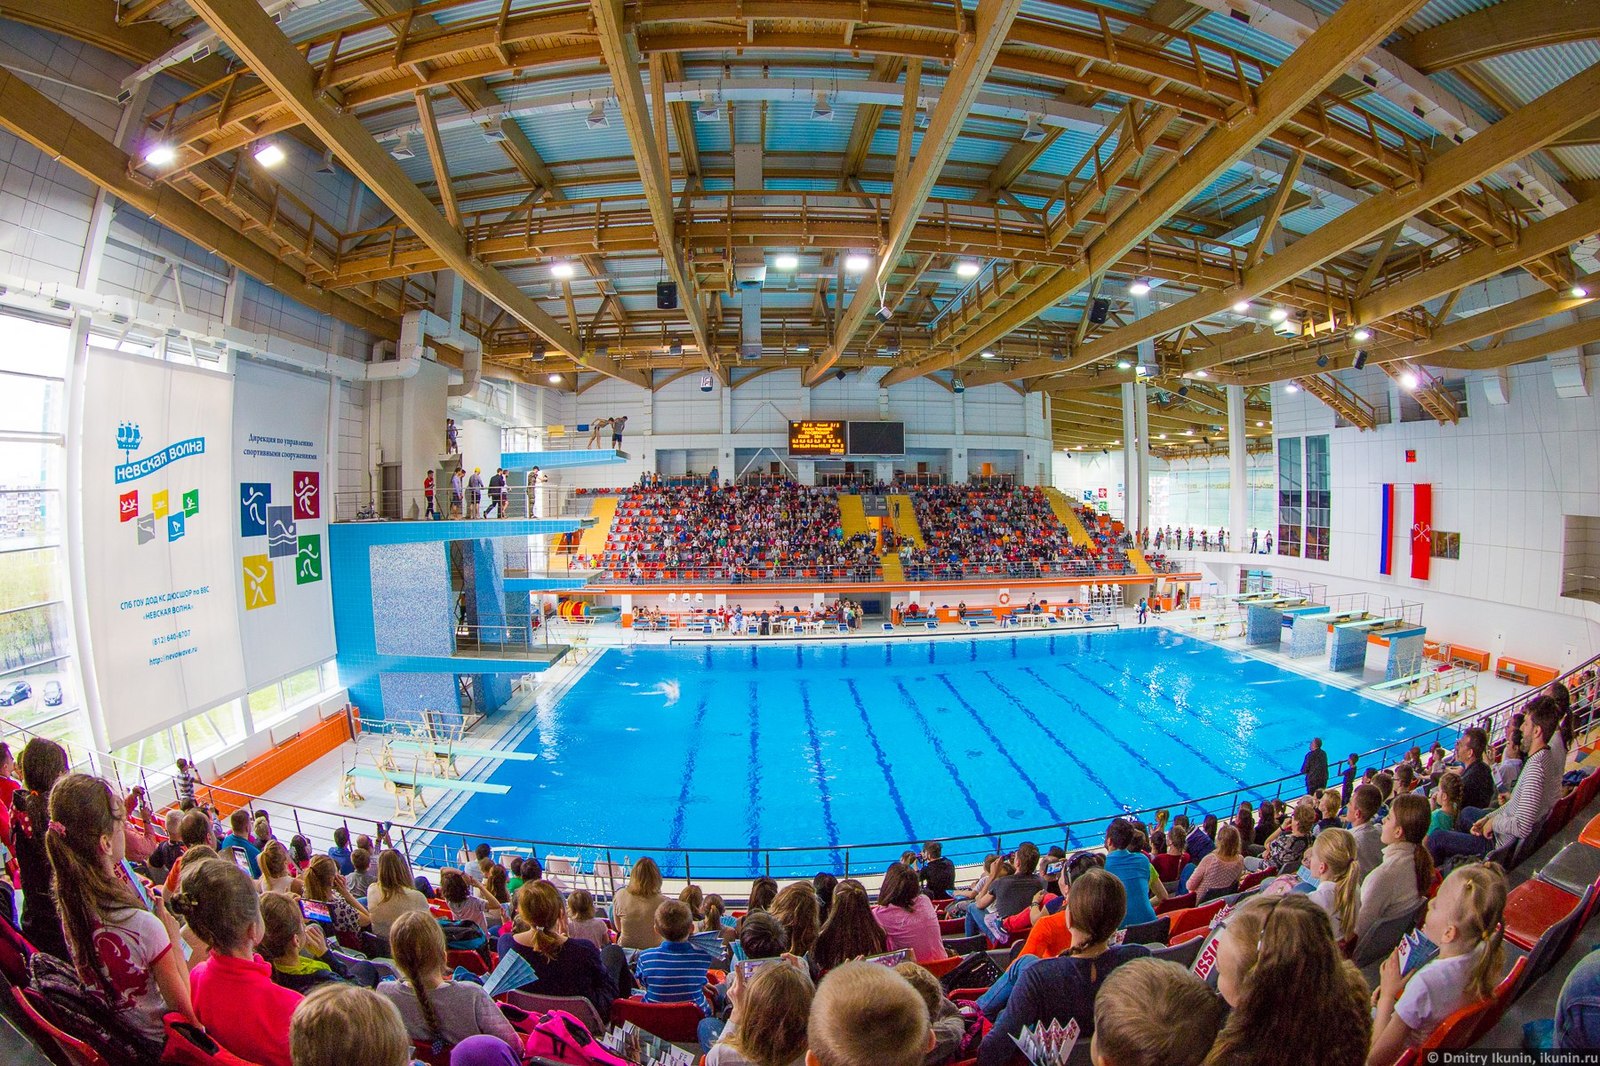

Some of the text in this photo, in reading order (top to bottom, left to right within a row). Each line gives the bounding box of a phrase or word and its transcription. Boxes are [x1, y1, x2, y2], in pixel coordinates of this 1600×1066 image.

[248, 433, 276, 444] Дирекция
[284, 438, 314, 448] управлению
[243, 449, 318, 461] спортивными сооружениями
